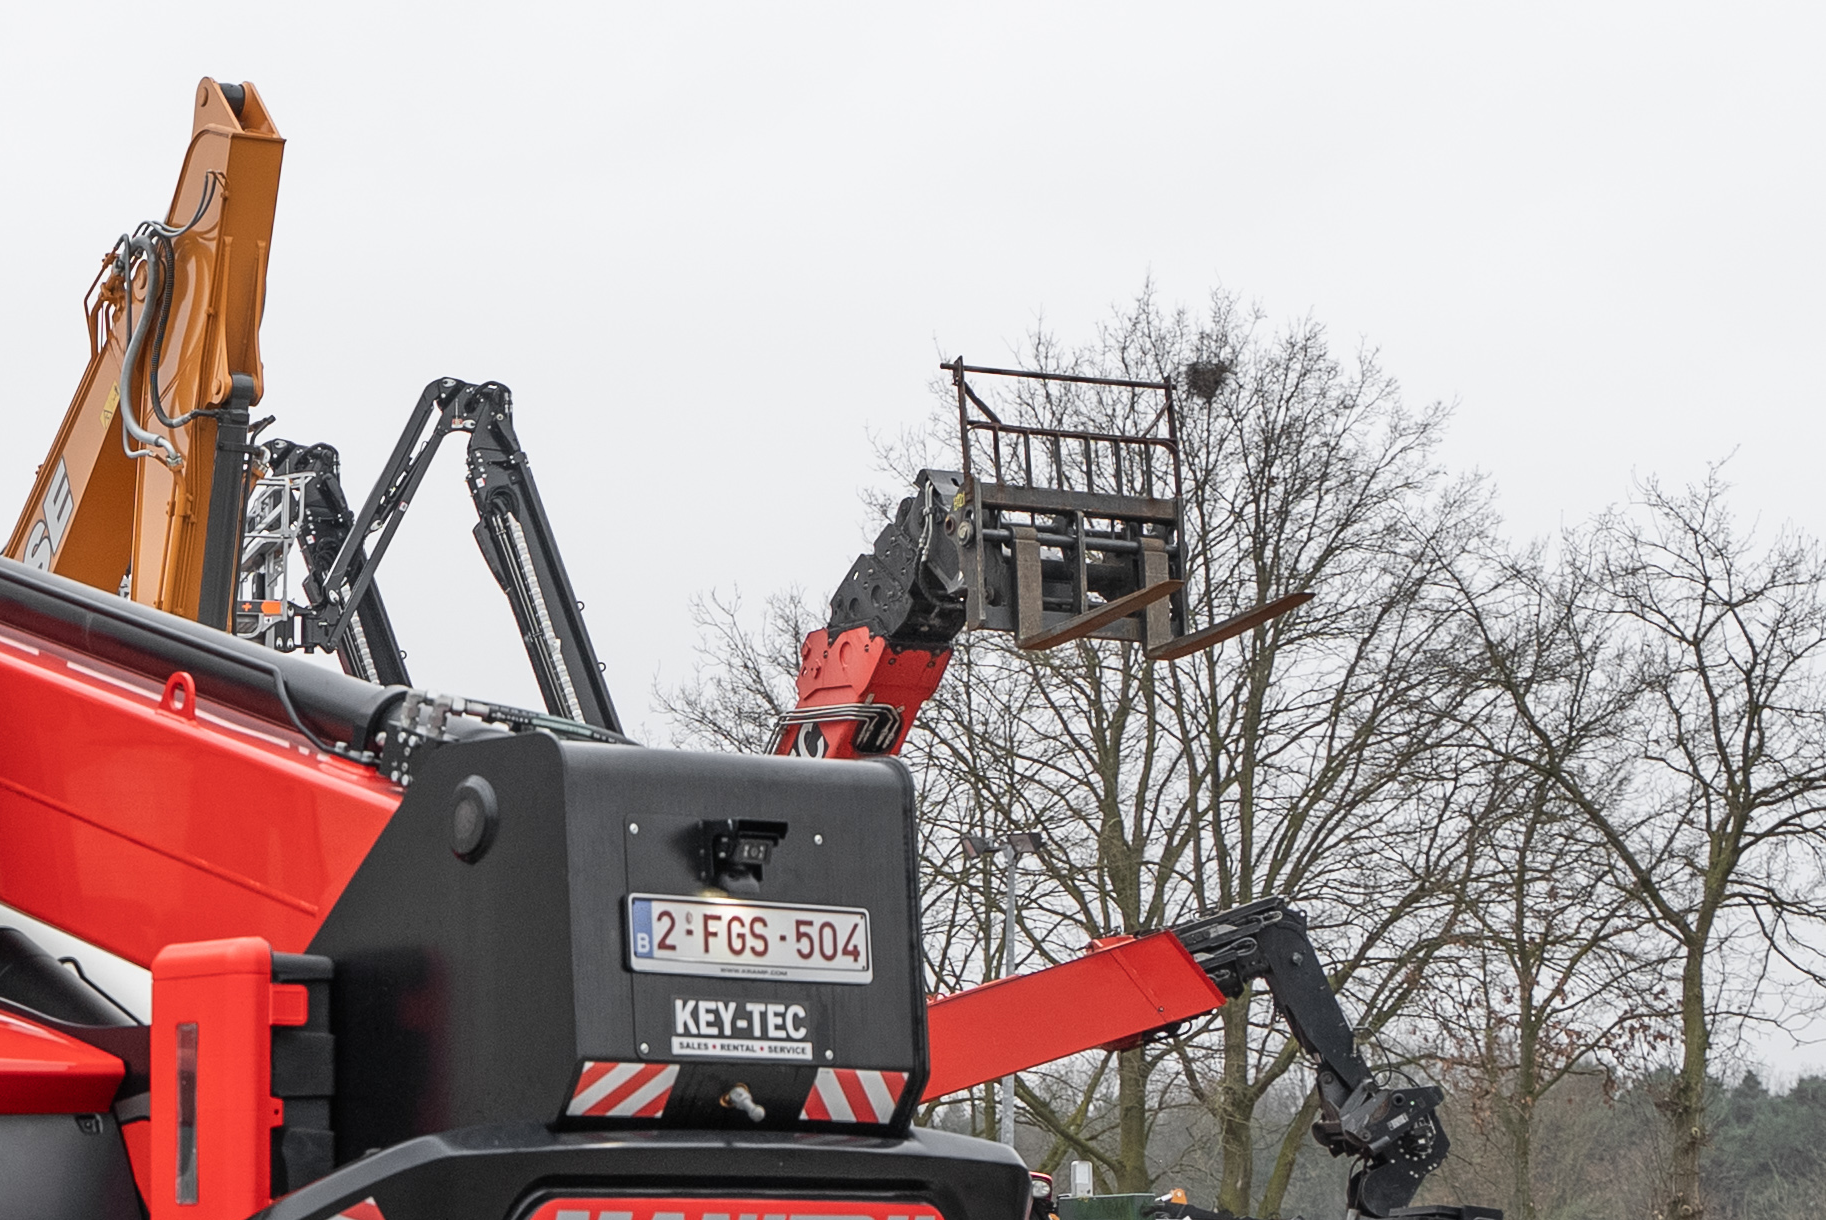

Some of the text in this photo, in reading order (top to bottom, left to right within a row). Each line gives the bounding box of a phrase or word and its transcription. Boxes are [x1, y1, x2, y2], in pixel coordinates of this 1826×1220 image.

[637, 932, 650, 953] B
[675, 999, 807, 1039] KEY-TEC
[679, 1042, 807, 1055] SALES RENTAL SERVICE
